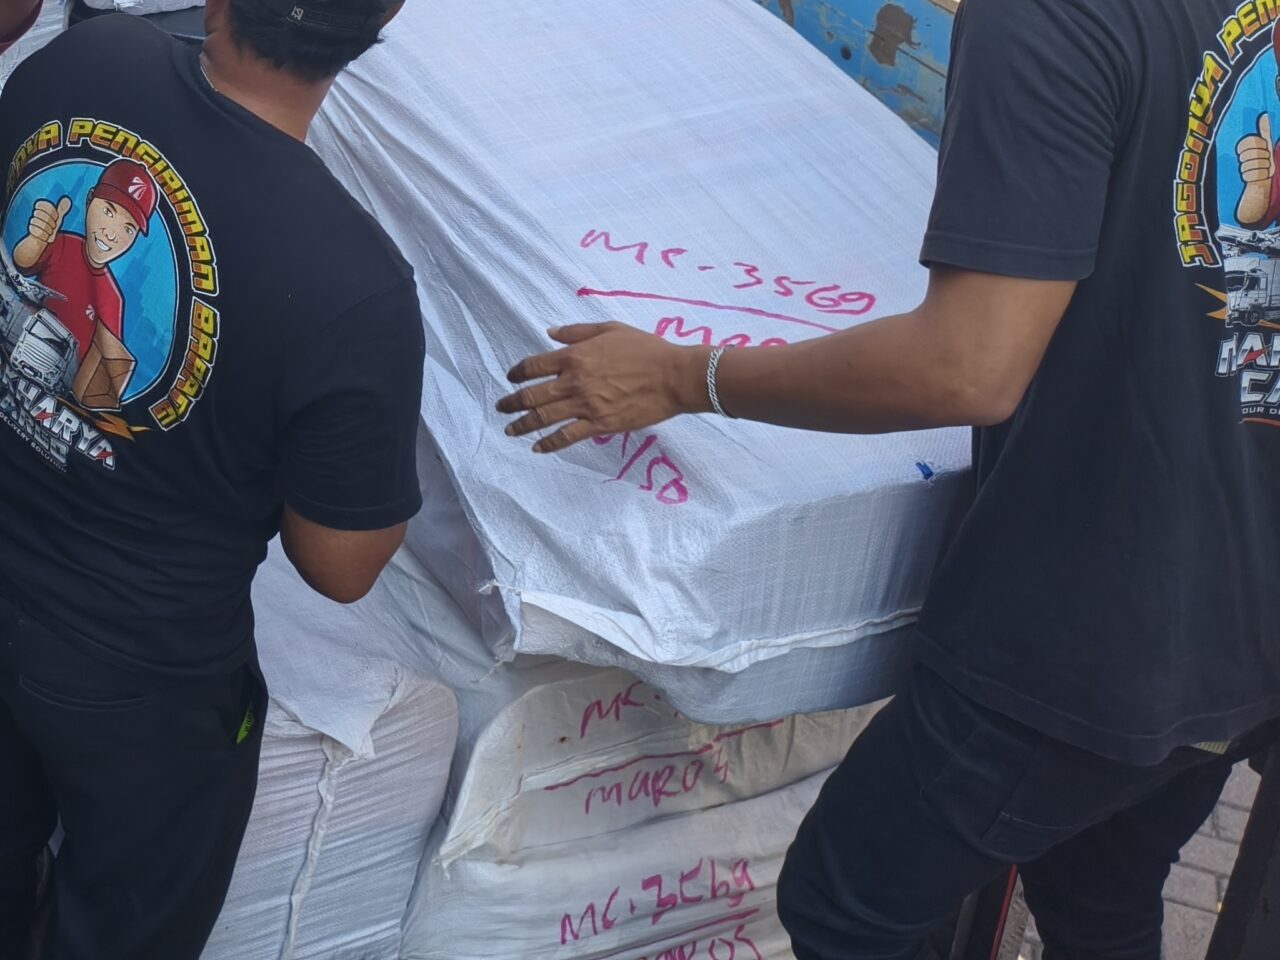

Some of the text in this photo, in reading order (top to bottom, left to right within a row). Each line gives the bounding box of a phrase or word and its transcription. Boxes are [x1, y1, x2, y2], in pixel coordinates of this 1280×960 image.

[67, 118, 219, 296] PENGIRIMAN
[149, 296, 219, 431] BARANG
[1174, 51, 1231, 267] JAGONYA
